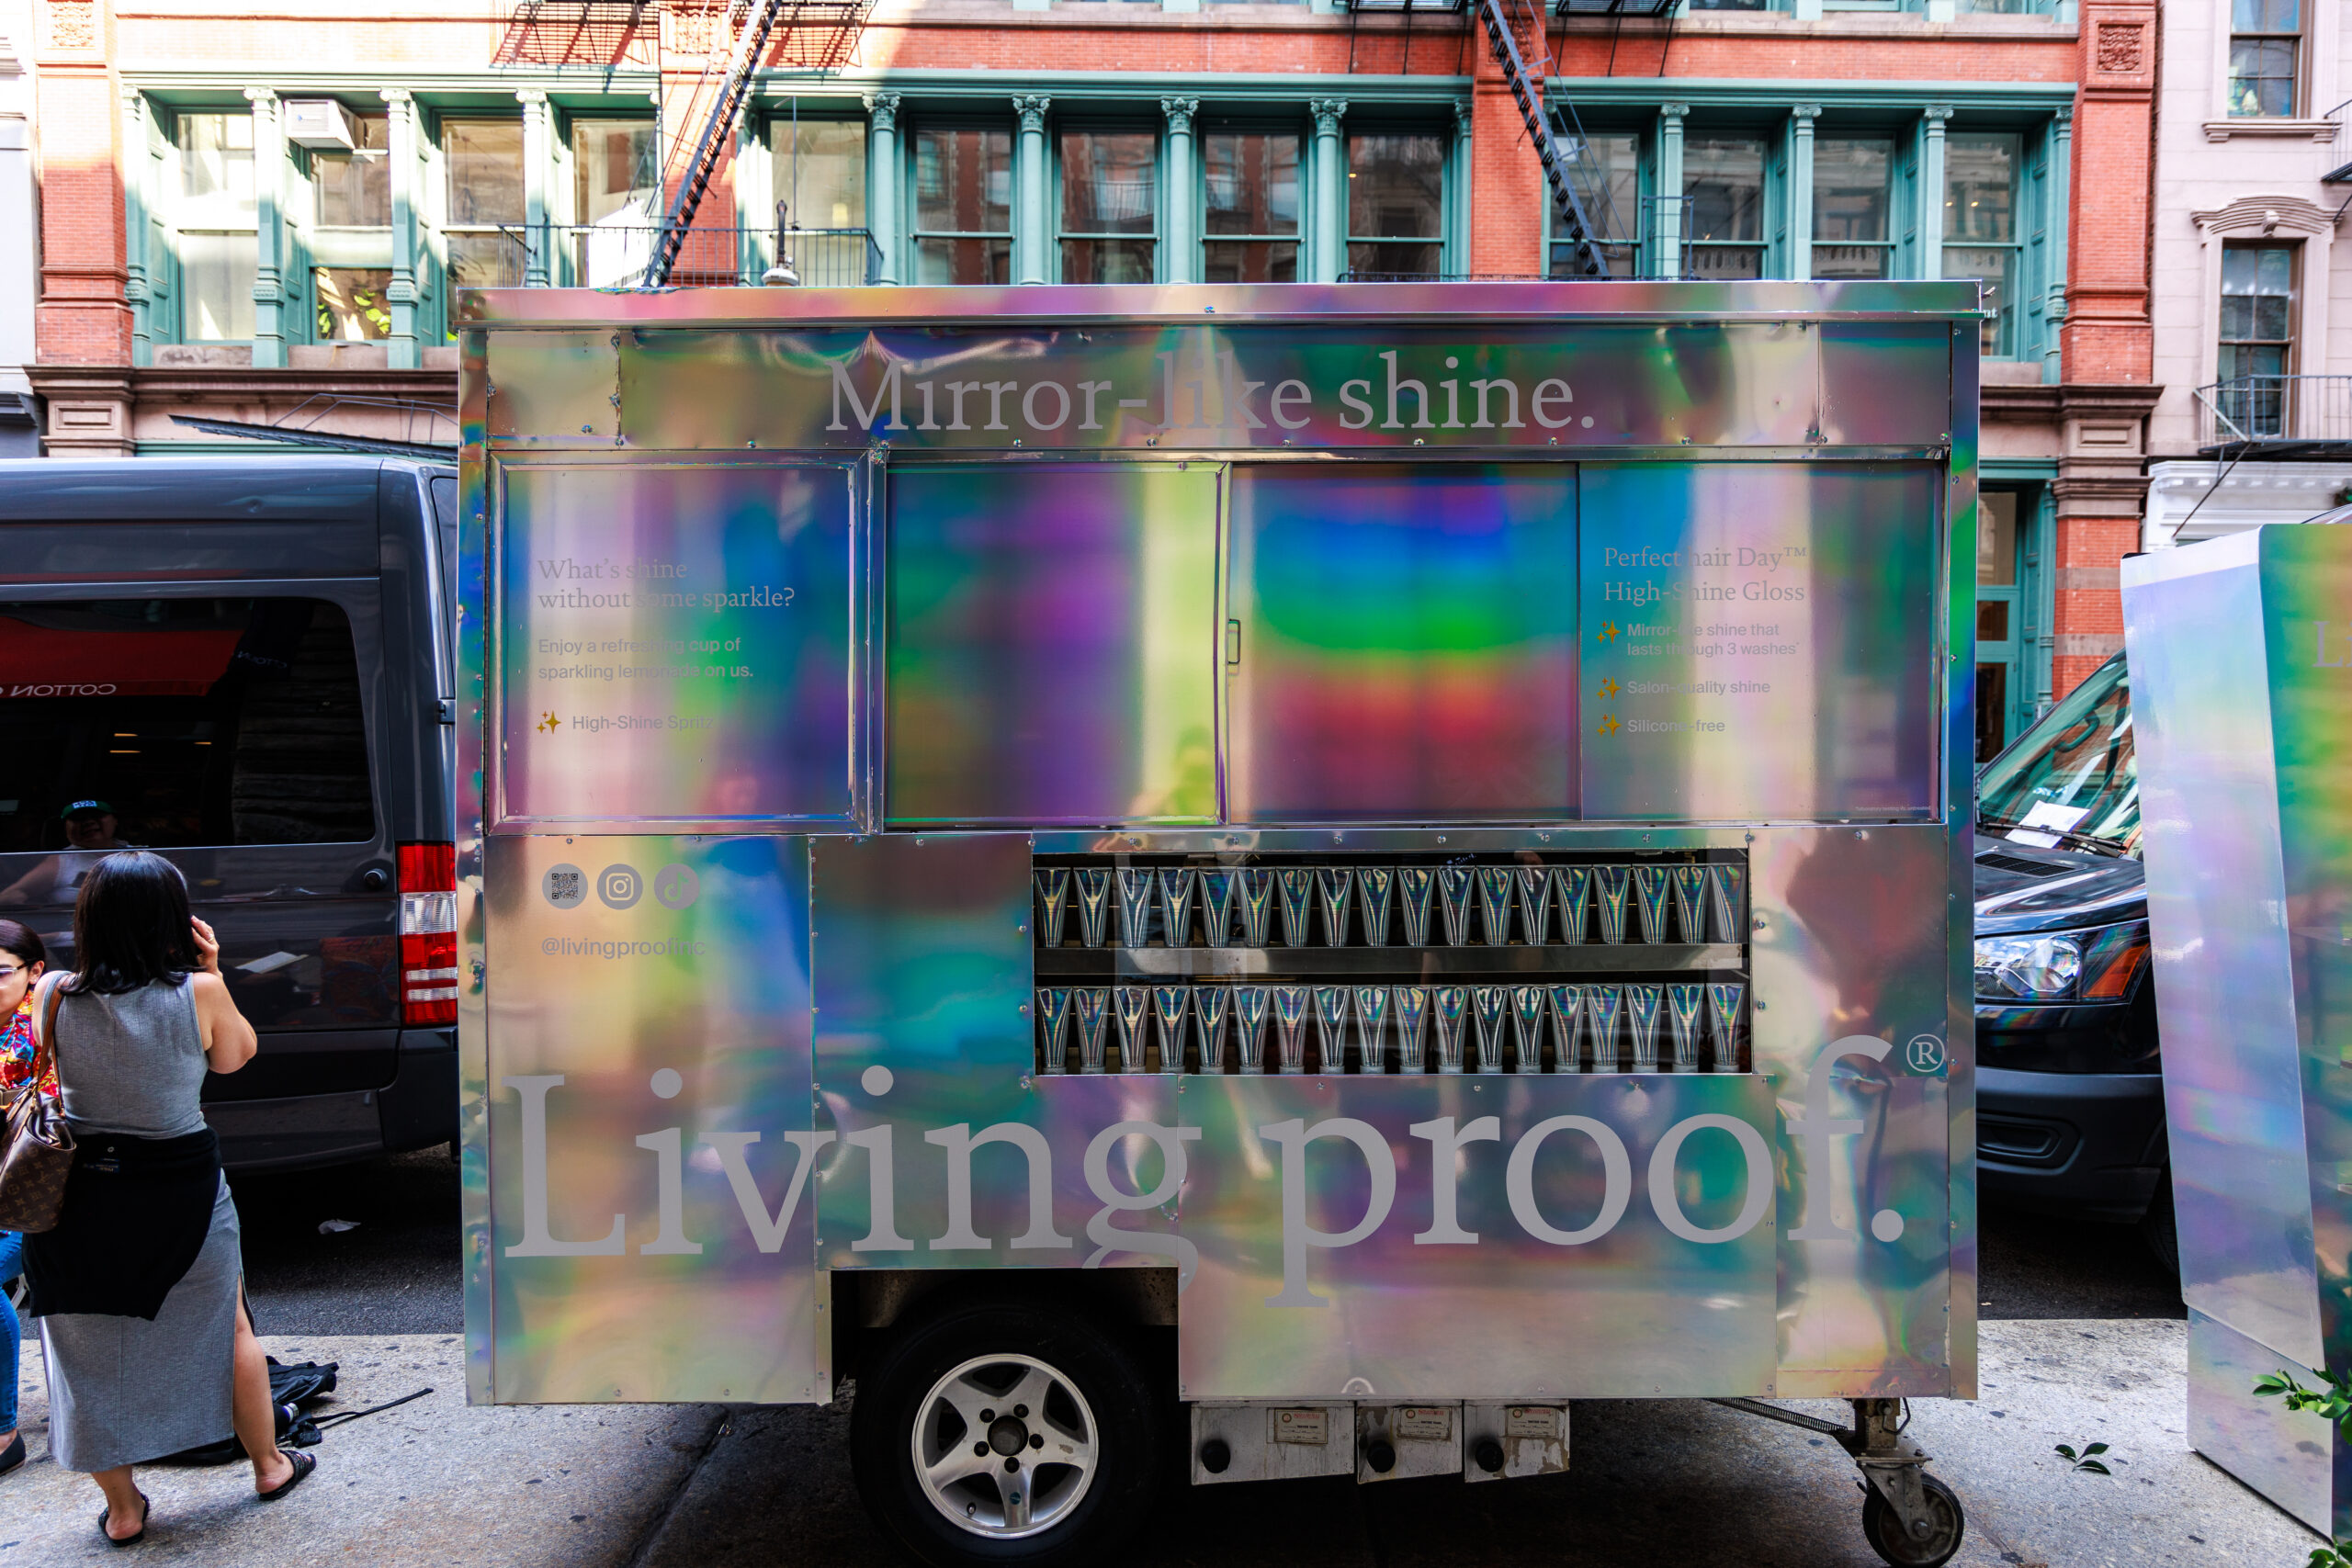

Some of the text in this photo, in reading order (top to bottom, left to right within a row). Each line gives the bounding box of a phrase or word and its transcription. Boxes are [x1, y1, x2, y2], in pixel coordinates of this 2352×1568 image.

[826, 350, 1595, 432] Mirror-like shine.
[1604, 546, 1682, 567] Perfect
[1688, 546, 1732, 567] hair
[537, 558, 688, 580] What's shine
[537, 586, 796, 613] without some sparkle?
[1604, 580, 1806, 607] High-Shine Gloss
[1706, 623, 1745, 637] shine
[1750, 623, 1780, 637] that
[537, 637, 741, 657] Enjoy a refreshing cup of
[1627, 642, 1662, 656] lasts
[1666, 642, 1724, 658] through
[1726, 642, 1737, 656] 3
[537, 663, 754, 682] sparkling lemonade on us.
[1627, 680, 1771, 696] Salon-quality shine
[572, 715, 714, 733] High-Shine Spritz
[1627, 719, 1726, 732] Silicone-free
[541, 937, 707, 960] @livingproofinc
[501, 1065, 1203, 1294] Living
